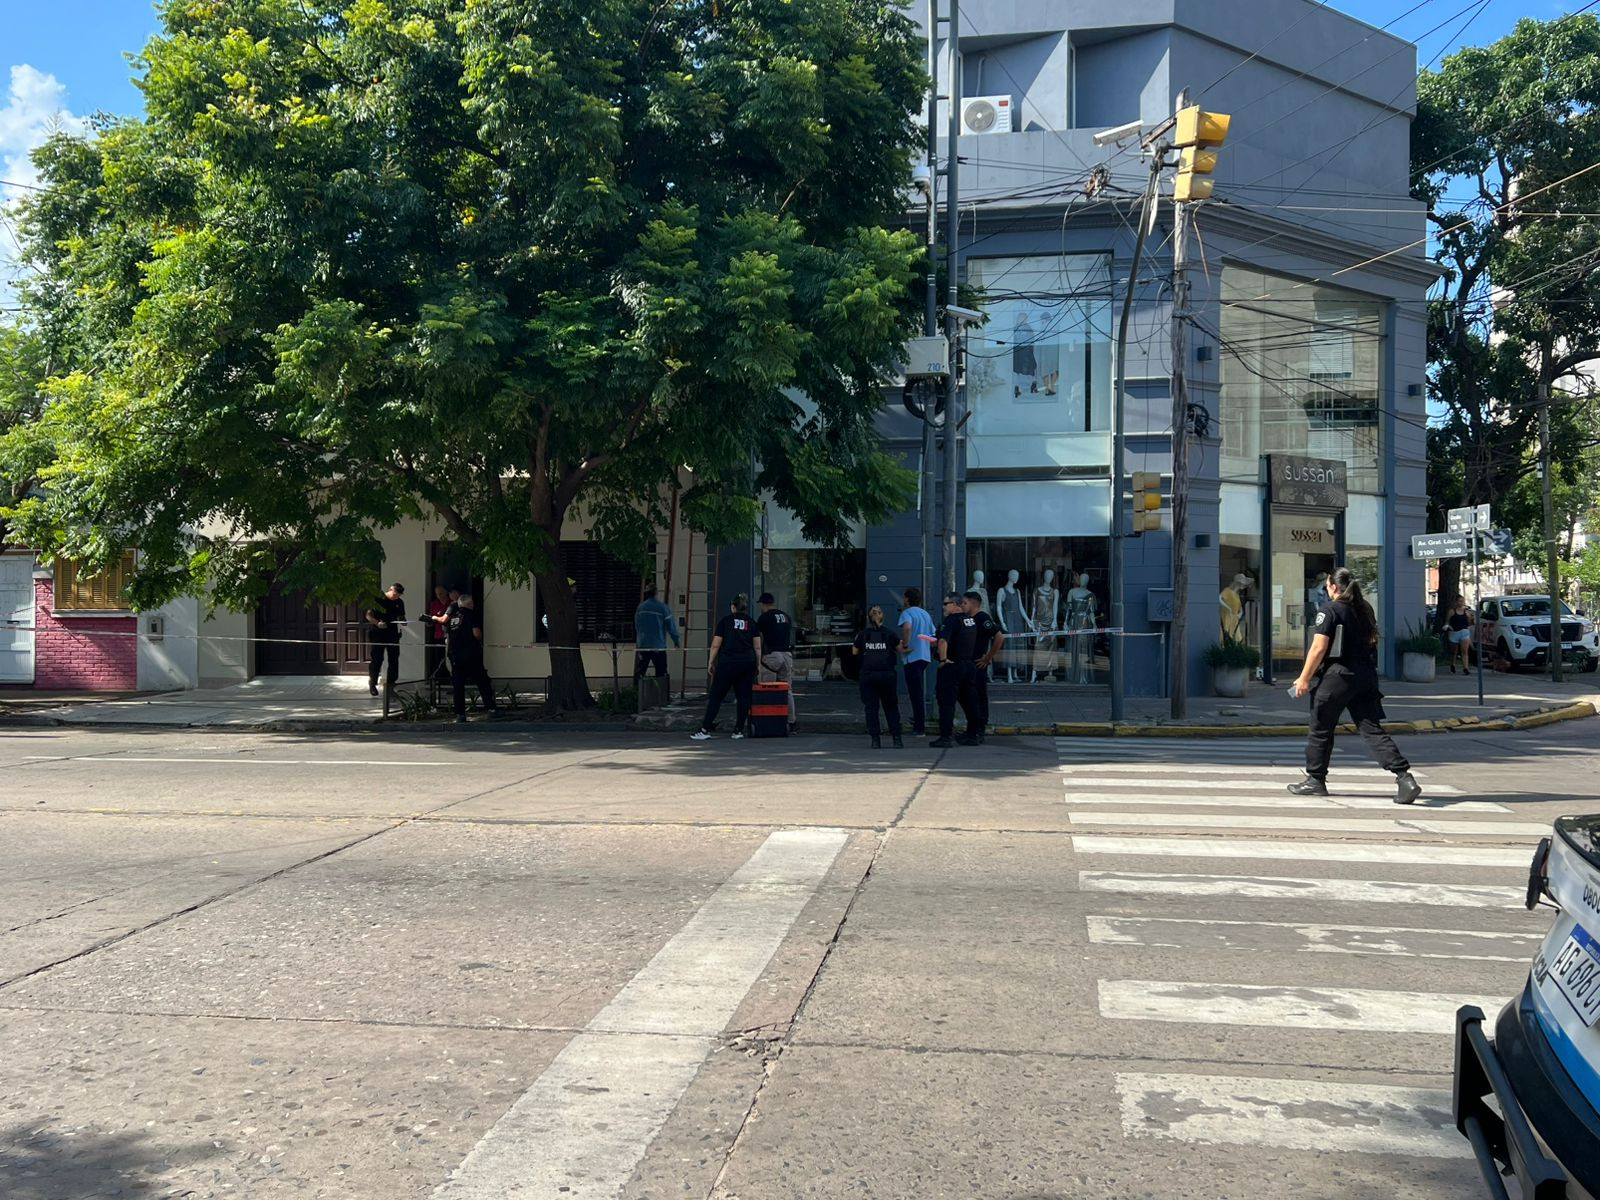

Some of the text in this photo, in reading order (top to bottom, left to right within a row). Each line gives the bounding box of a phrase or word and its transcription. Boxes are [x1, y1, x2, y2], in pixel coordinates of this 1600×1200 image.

[1284, 465, 1334, 483] sussan
[1418, 549, 1435, 557] 3100
[1553, 942, 1581, 976] AG
[1567, 958, 1600, 998] 696
